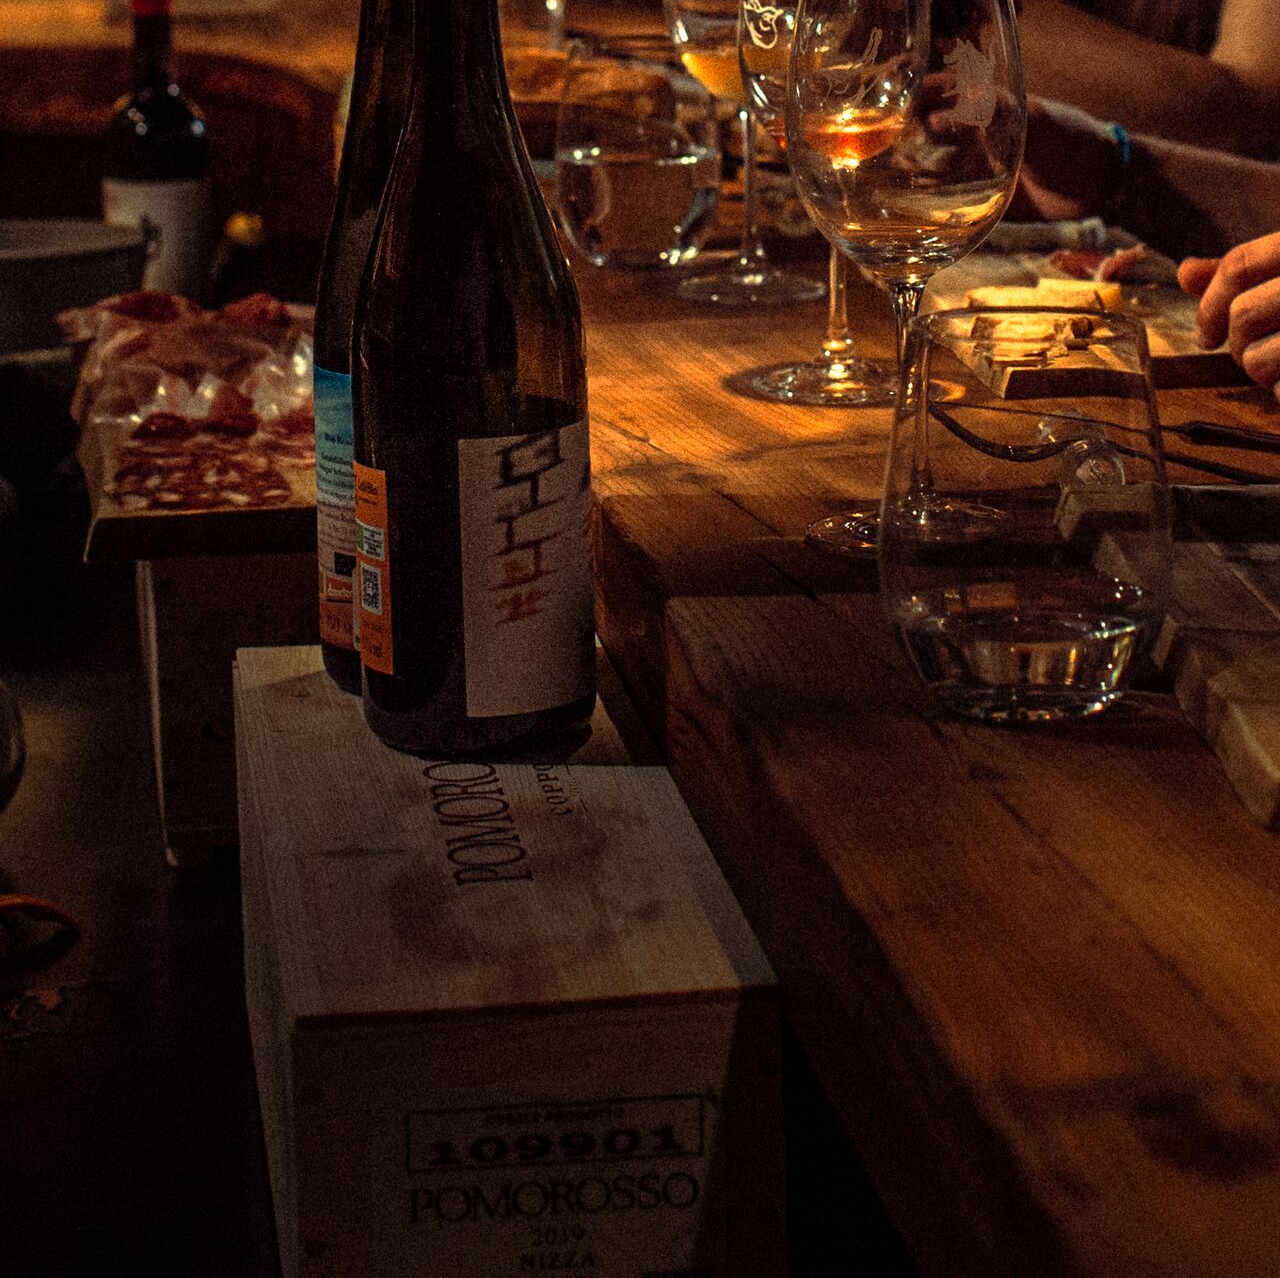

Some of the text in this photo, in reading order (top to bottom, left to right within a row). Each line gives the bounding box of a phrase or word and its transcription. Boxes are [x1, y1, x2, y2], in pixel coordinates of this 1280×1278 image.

[430, 1124, 686, 1166] 109901
[410, 1172, 700, 1223] POMOROSSO
[519, 1251, 596, 1270] NIZZA
